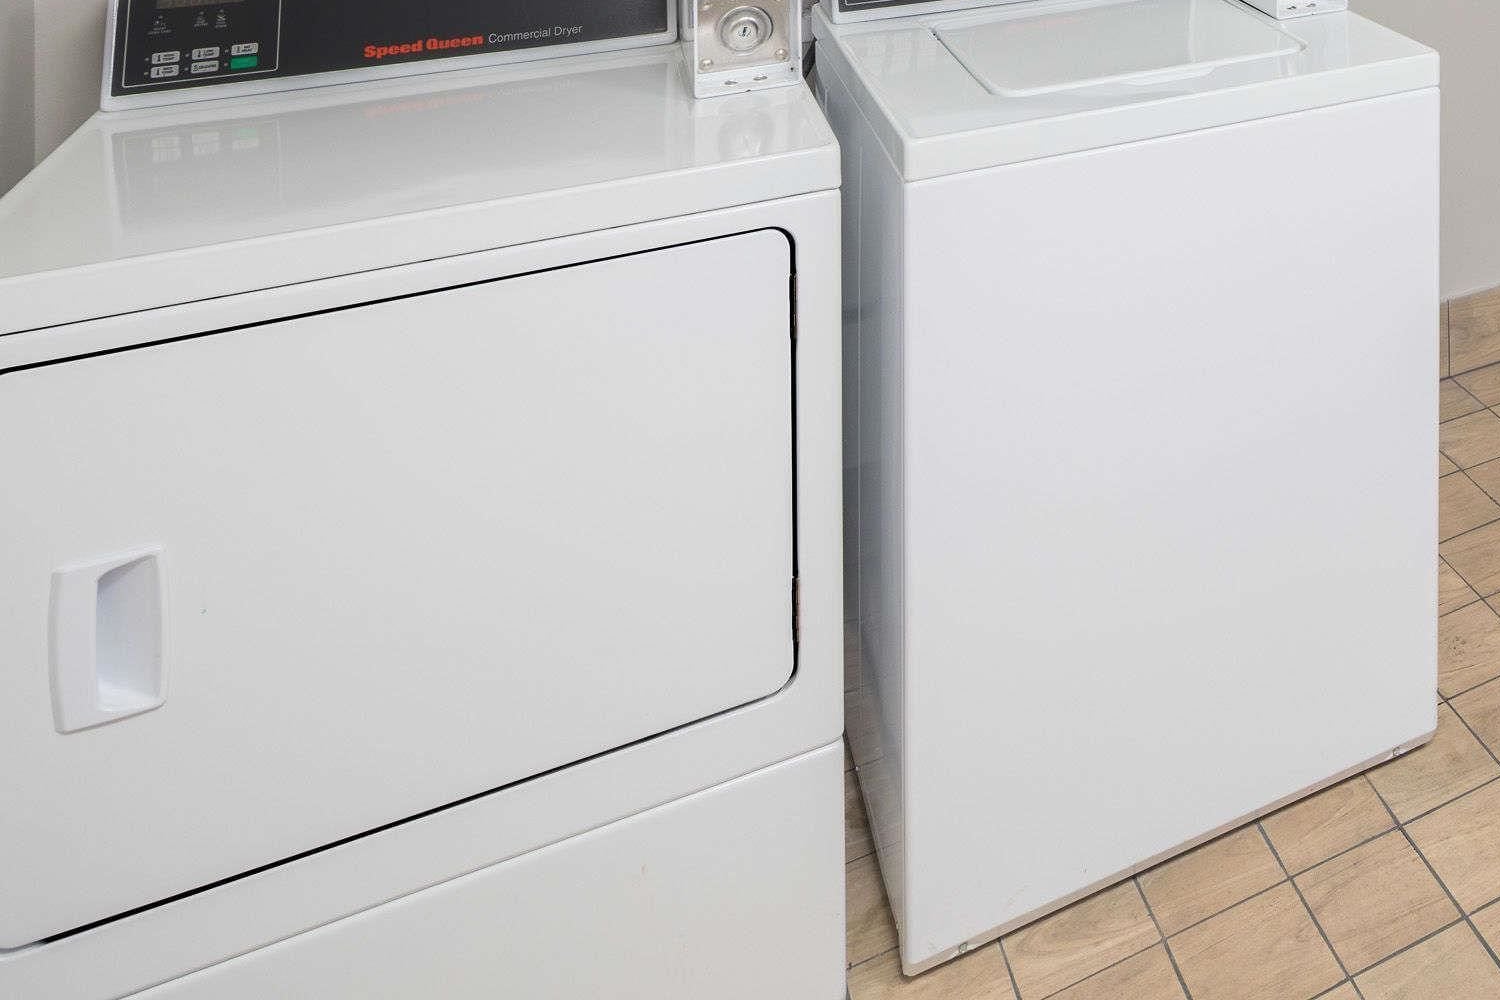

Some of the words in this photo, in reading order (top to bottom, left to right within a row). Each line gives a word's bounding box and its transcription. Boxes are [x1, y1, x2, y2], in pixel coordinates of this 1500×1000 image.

[363, 40, 424, 58] Speed
[426, 34, 484, 50] Queen
[488, 28, 550, 44] Commercial
[554, 24, 583, 38] Dryer
